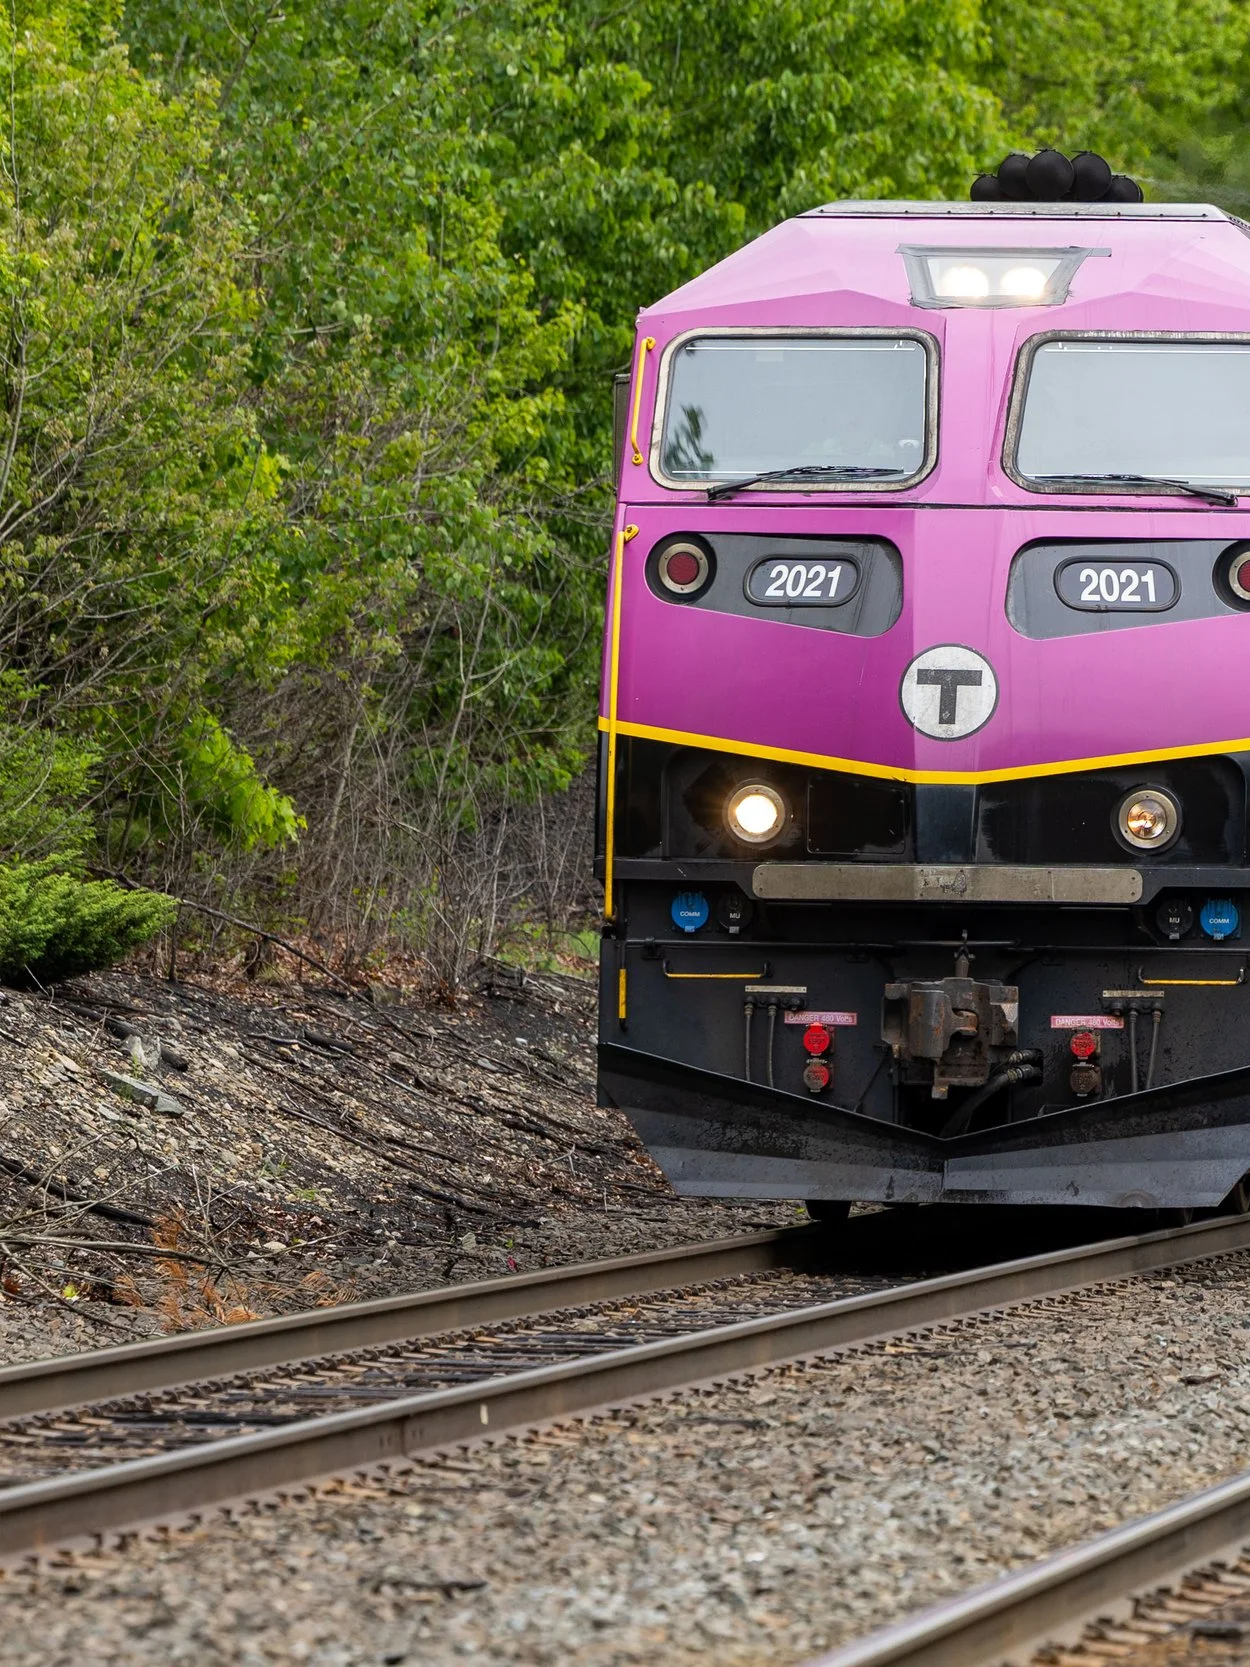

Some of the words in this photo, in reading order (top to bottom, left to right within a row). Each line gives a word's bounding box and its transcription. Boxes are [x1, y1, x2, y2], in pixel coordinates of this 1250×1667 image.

[764, 564, 842, 598] 2021
[1079, 568, 1156, 603] 2021
[916, 668, 983, 725] T
[788, 1014, 820, 1022] DANGER
[1055, 1018, 1087, 1026] DANGER
